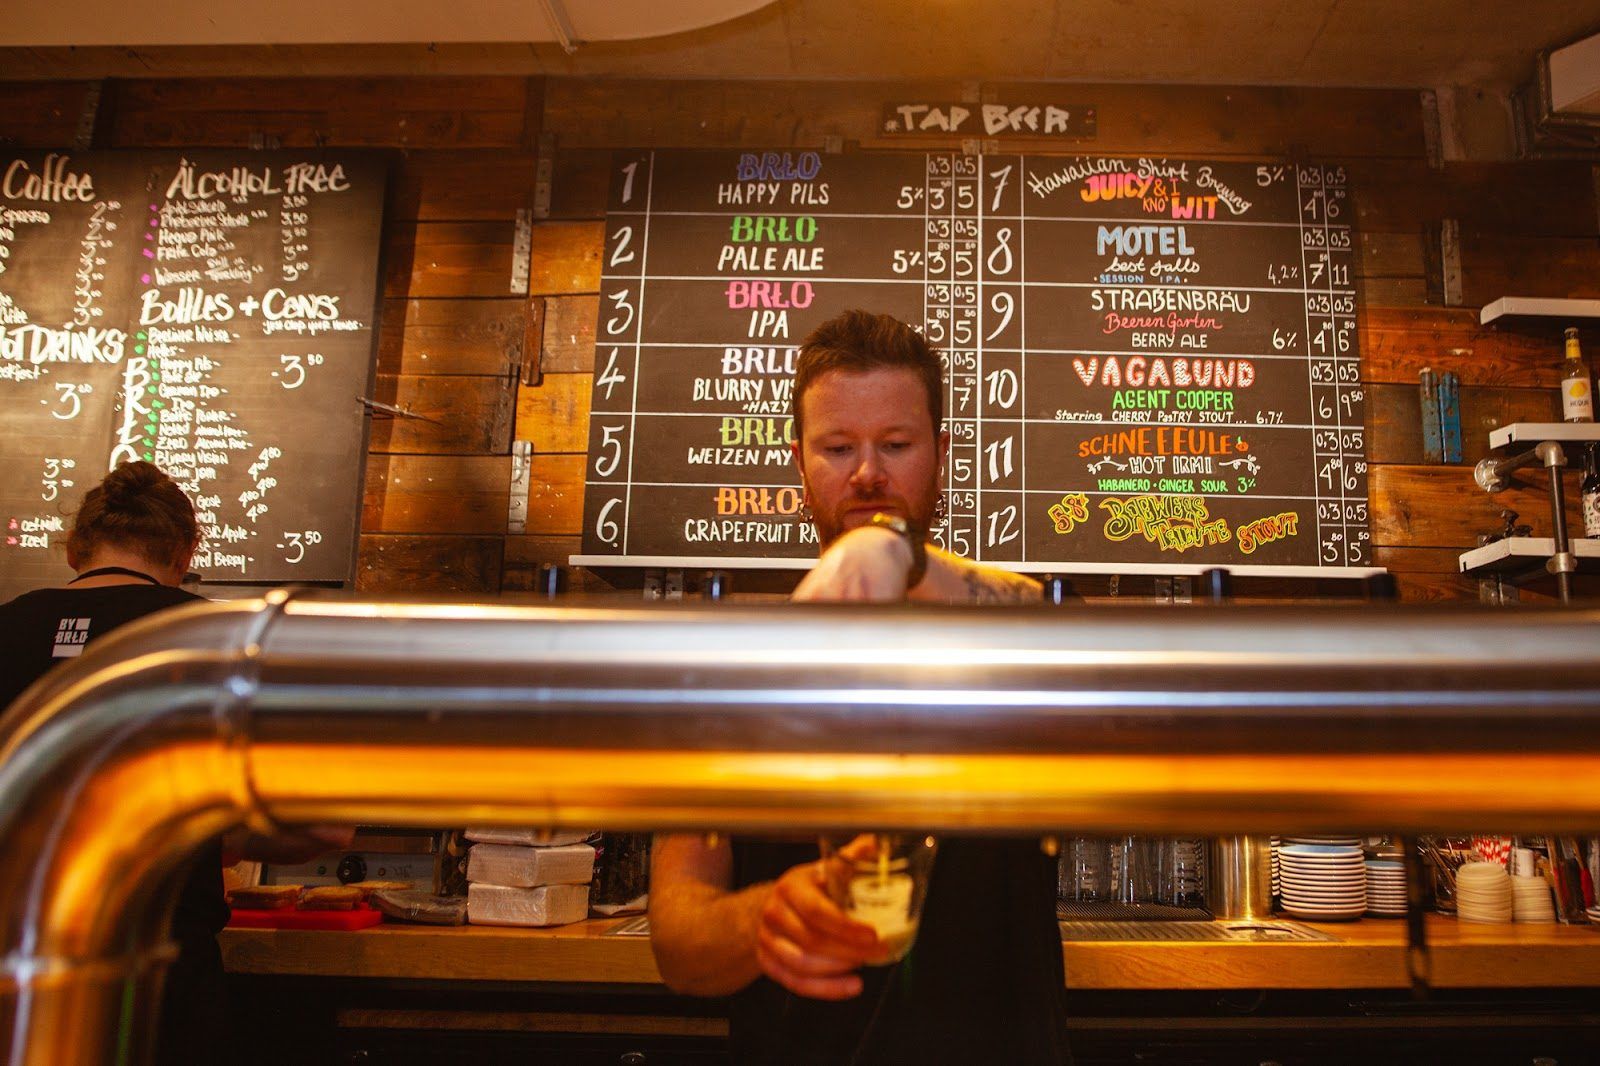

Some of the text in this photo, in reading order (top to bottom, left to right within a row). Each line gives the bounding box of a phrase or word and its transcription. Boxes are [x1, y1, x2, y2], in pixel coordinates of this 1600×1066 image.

[896, 103, 1069, 136] TAP BEER
[3, 153, 95, 202] Coffee
[622, 162, 638, 203] 1
[989, 165, 1012, 212] 7
[1081, 172, 1155, 203] JUICY
[718, 183, 780, 205] HAPPY
[790, 183, 829, 205] PILS
[1171, 196, 1218, 219] WIT
[610, 226, 635, 268] 2
[987, 227, 1013, 275] 8
[1097, 225, 1195, 257] MOTEL
[717, 245, 777, 271] PALE
[782, 247, 824, 271] ALE
[1099, 274, 1144, 285] SESSION
[607, 289, 634, 335] 3
[748, 310, 789, 338] IPA
[986, 291, 1014, 342] 9
[1132, 333, 1176, 348] BERRY
[1181, 334, 1208, 349] ALE
[596, 347, 626, 400] 4
[1072, 356, 1256, 388] VAGABUND
[693, 378, 763, 401] BLURRY
[985, 368, 1018, 409] 10
[1112, 390, 1234, 411] AGENT COOPER
[1055, 410, 1103, 423] Starring
[1111, 410, 1152, 422] CHERRY
[1319, 395, 1332, 419] 6
[595, 425, 625, 477] 5
[688, 447, 760, 465] WEIZEN
[984, 436, 1013, 483] 11
[1128, 456, 1213, 474] HOT IRMI
[1098, 479, 1151, 492] HABANERO
[1159, 480, 1195, 492] GINGER
[1201, 481, 1229, 493] SOUR
[684, 518, 820, 543] GRAPEFRUIT RA
[987, 505, 1020, 548] 12
[1236, 512, 1299, 554] STOUT
[59, 618, 77, 630] BY
